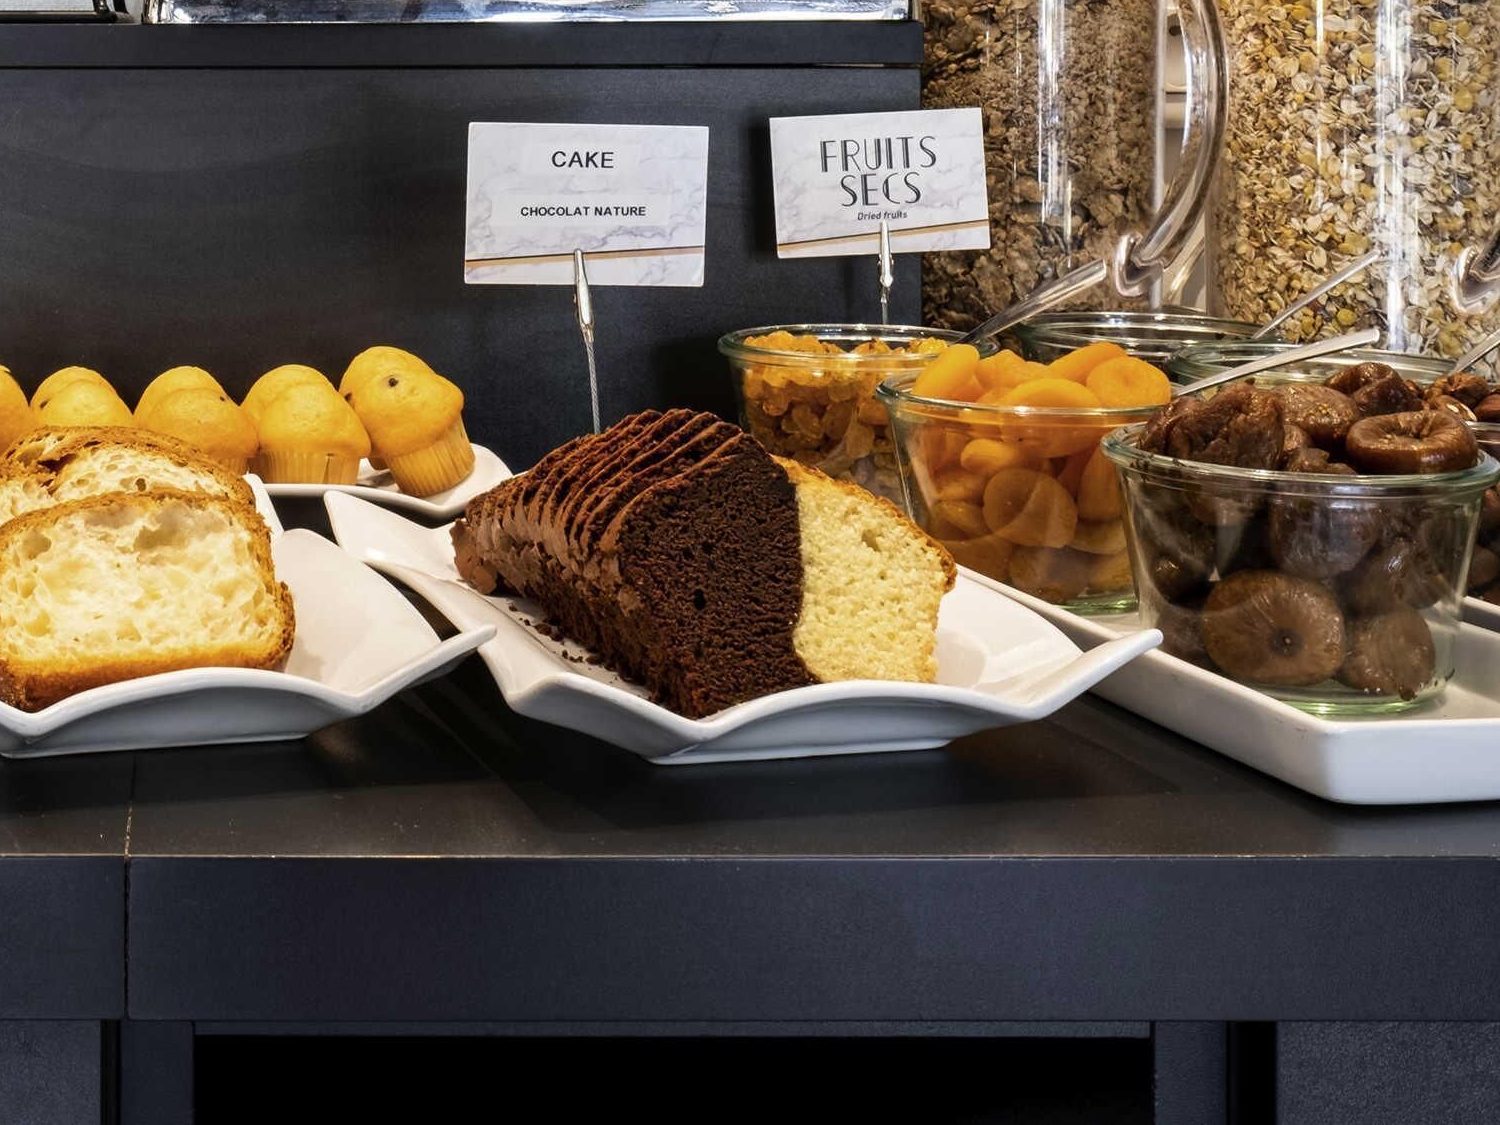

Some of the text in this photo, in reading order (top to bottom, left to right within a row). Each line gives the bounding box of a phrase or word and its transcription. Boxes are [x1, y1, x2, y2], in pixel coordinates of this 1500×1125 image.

[551, 150, 615, 169] CAKE
[820, 135, 937, 173] FRUITS
[840, 172, 922, 207] SECS
[520, 206, 647, 217] CHOCOLAT NATURE
[857, 210, 908, 221] Dried fruits
